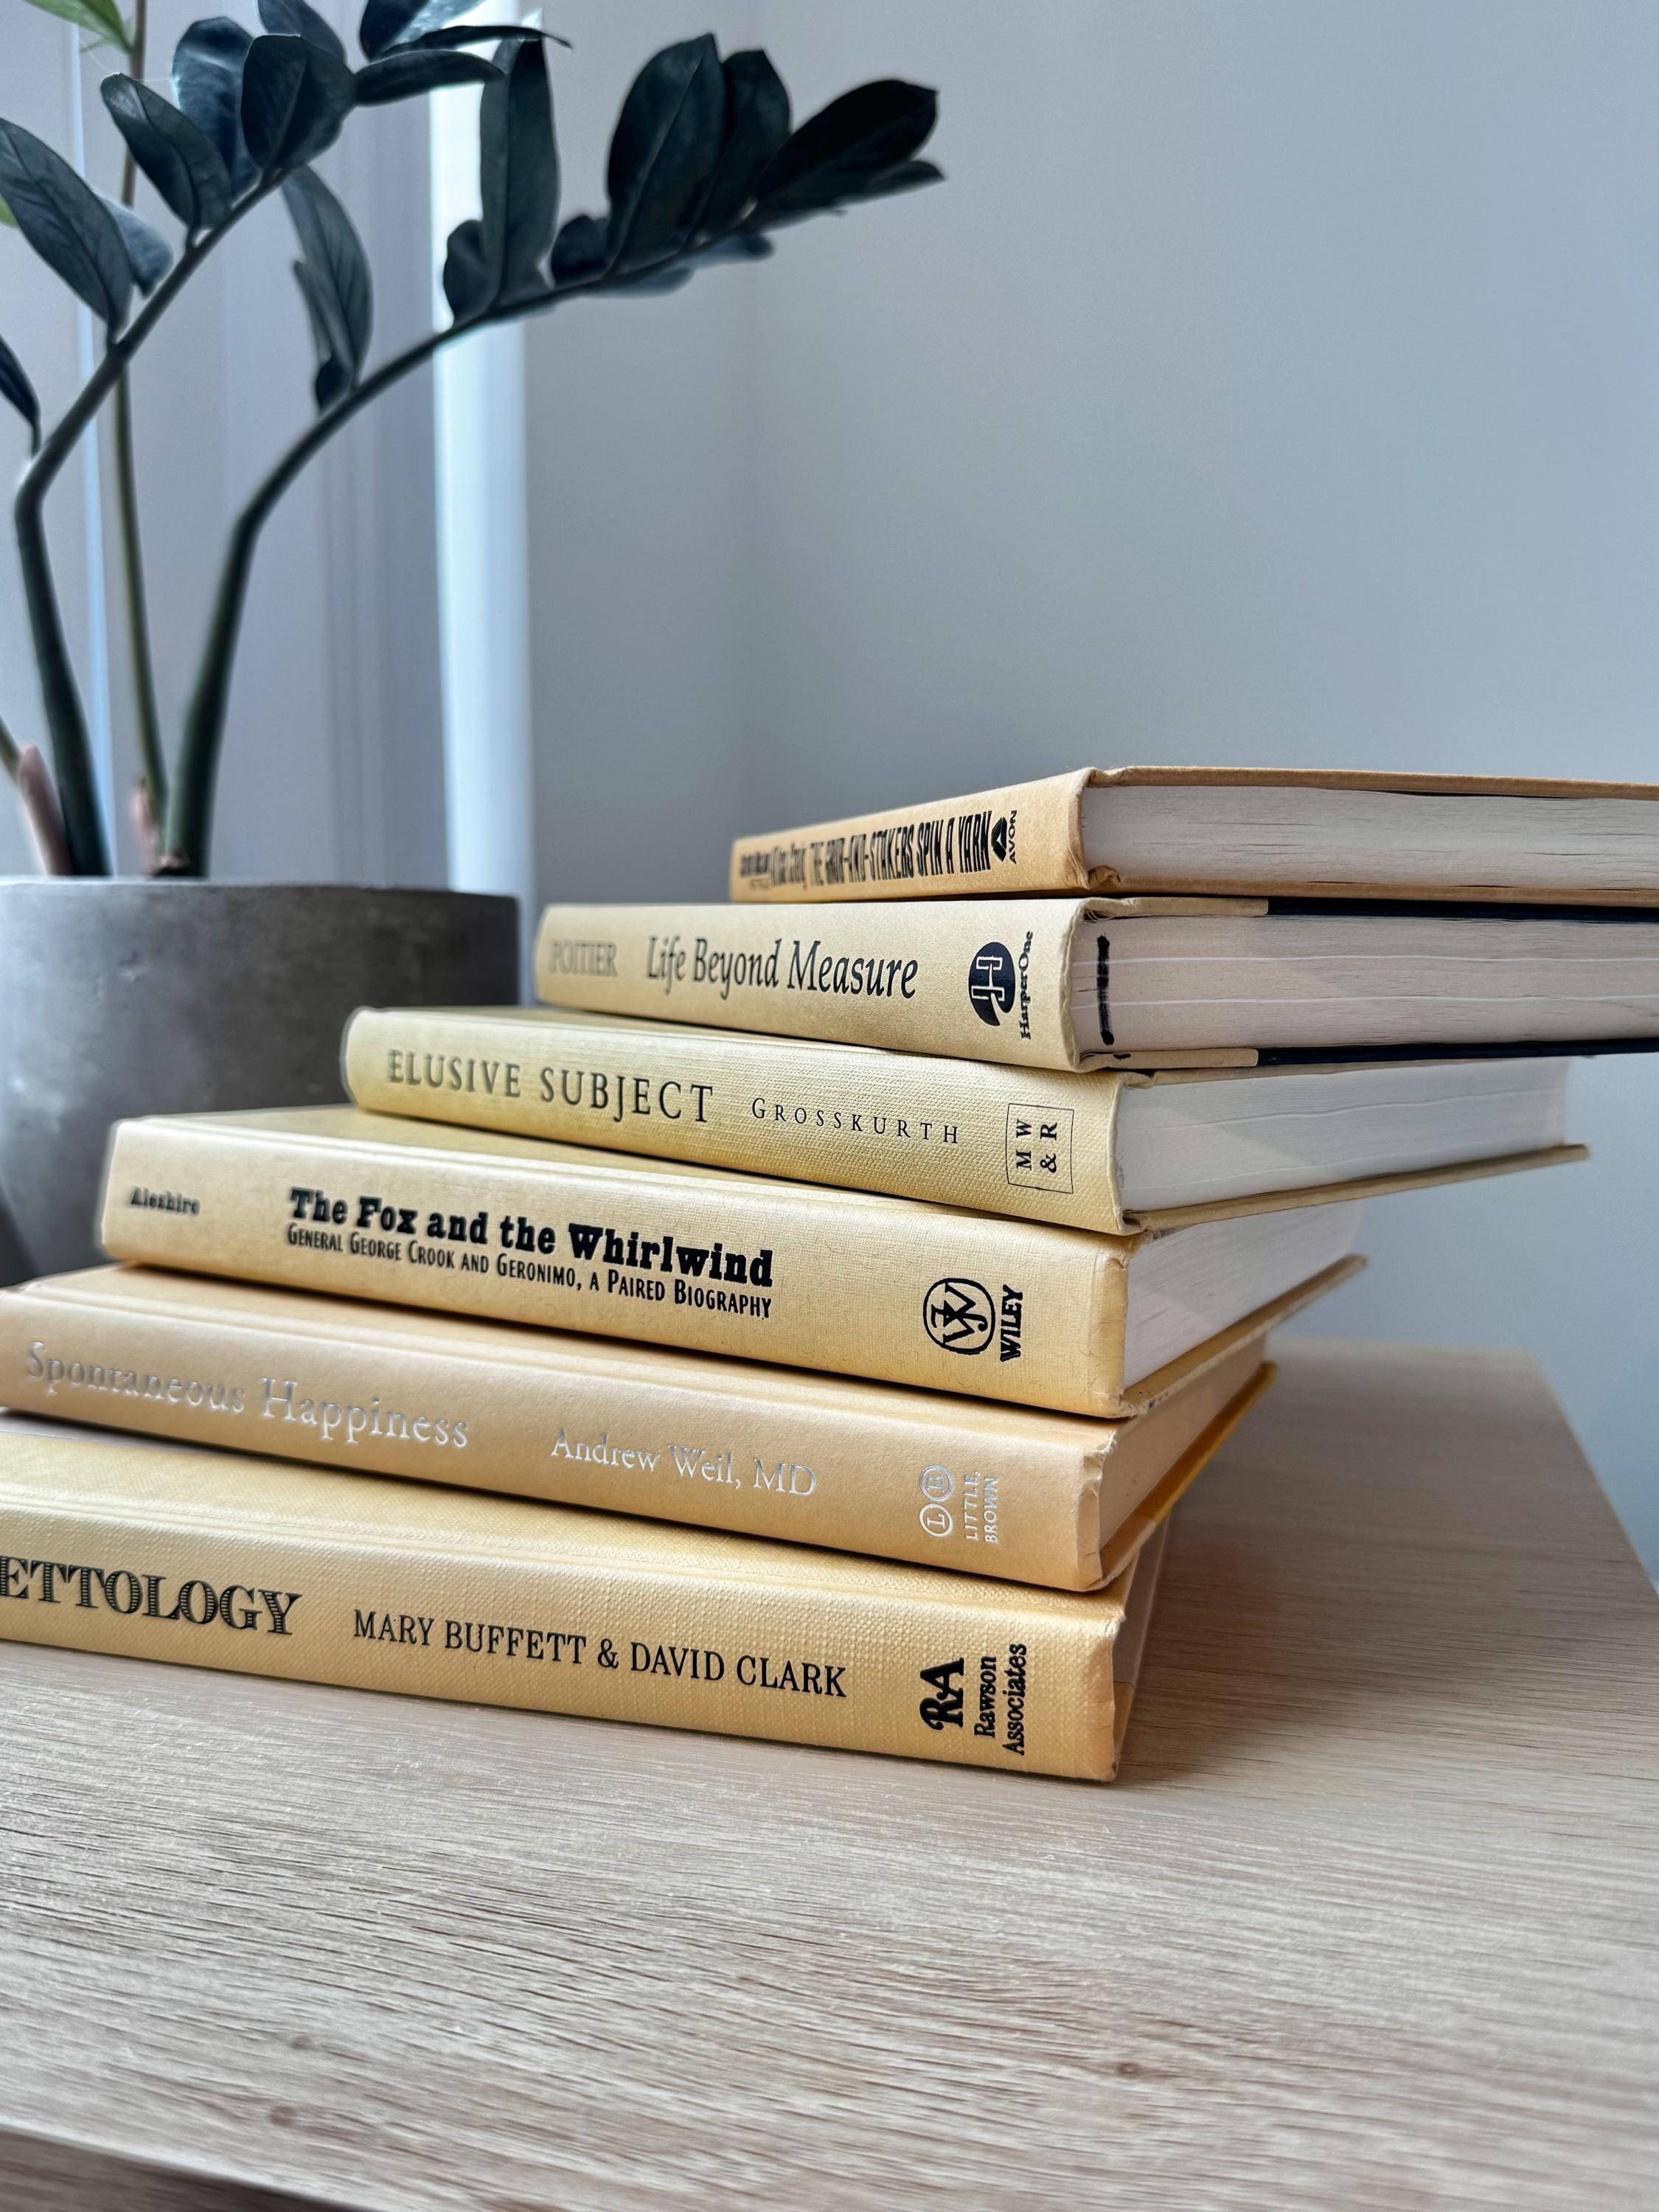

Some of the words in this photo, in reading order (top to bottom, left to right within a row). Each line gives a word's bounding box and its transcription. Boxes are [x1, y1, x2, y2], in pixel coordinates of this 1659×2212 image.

[917, 819, 943, 877] SPIN
[946, 817, 956, 874] A
[958, 810, 992, 873] YARN
[1009, 810, 1018, 864] AVON
[646, 934, 686, 997] Life
[693, 937, 782, 1001] Beyond
[787, 939, 919, 1000] Measure
[1019, 930, 1033, 1040] HarperOne
[386, 1048, 521, 1098] ELUSIVE
[540, 1066, 714, 1123] SUBJECT
[751, 1097, 959, 1144] GROSSKURTH
[287, 1221, 344, 1253] GENERAL
[349, 1231, 402, 1262] GEORGE
[408, 1239, 455, 1270] CROOK
[461, 1252, 489, 1274] AND
[496, 1252, 582, 1292] GERONIMO,
[608, 1269, 666, 1301] PAIRED
[674, 1279, 772, 1319] BIOGRAPHY
[290, 1186, 349, 1225] The
[357, 1194, 418, 1236] Fox
[428, 1211, 489, 1245] and
[500, 1214, 556, 1254] the
[568, 1222, 773, 1288] Whirlwind
[1000, 1284, 1023, 1363] WILEY
[26, 1340, 245, 1413] Spontaneous
[259, 1376, 469, 1449] Happiness
[550, 1427, 661, 1472] Andrew
[667, 1444, 742, 1489] Weil,
[753, 1457, 817, 1497] MD
[984, 1476, 998, 1545] BROWN
[0, 1554, 303, 1635] ETTOLOGY
[354, 1609, 435, 1646] MARY
[444, 1618, 587, 1664] BUFFETT
[597, 1638, 619, 1669] &
[630, 1641, 726, 1681] DAVID
[737, 1654, 847, 1698] CLARK
[919, 1657, 964, 1731] RA
[973, 1655, 997, 1738] Rawson
[1002, 1643, 1027, 1756] Associates
